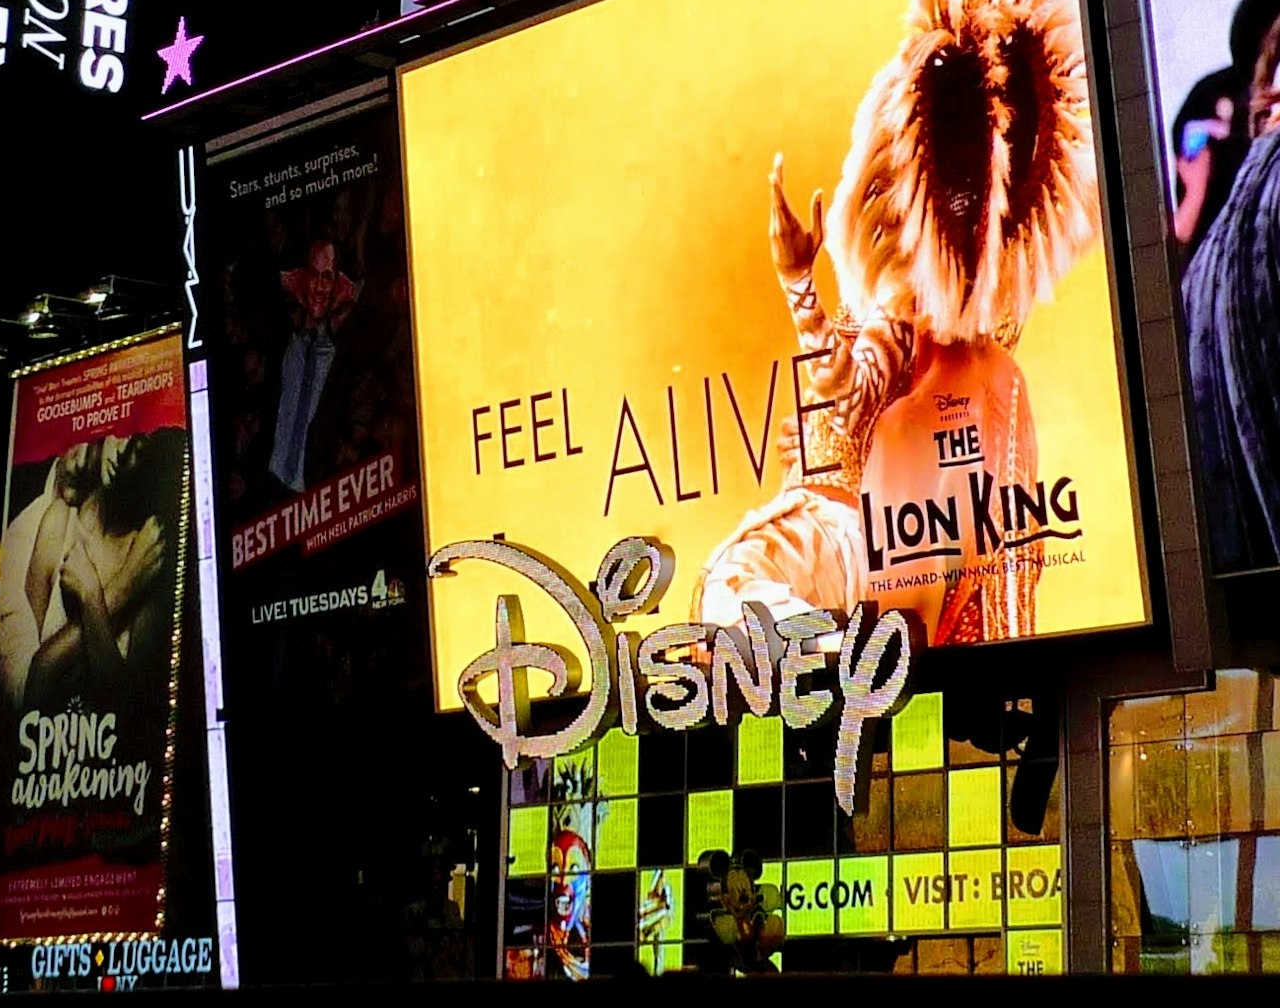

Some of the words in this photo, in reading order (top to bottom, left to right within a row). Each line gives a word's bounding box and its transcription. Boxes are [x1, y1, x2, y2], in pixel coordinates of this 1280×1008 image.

[229, 178, 262, 199] Stars,
[304, 143, 360, 174] surprises,
[265, 184, 287, 209] and
[289, 186, 303, 201] so
[305, 167, 340, 196] much
[342, 152, 379, 182] more!
[35, 391, 104, 424] GOOSEBUMPS
[116, 370, 175, 401] TEARDROPS
[71, 415, 85, 433] TO
[86, 404, 119, 429] PROVE
[120, 400, 135, 420] IT
[471, 387, 584, 476] FEEL
[603, 348, 844, 518] ALIVE
[933, 424, 981, 462] THE
[231, 511, 279, 573] BEST
[280, 484, 333, 543] TIME
[337, 453, 395, 515] EVER
[305, 529, 328, 552] WITH
[328, 518, 348, 540] NEIL
[348, 500, 384, 531] PATRICK
[384, 484, 418, 513] HARRIS
[860, 491, 961, 572] LION
[968, 469, 1080, 556] KING
[251, 600, 288, 625] LIVE!
[289, 583, 369, 619] TUESDAYS
[371, 568, 388, 601] 4
[870, 579, 893, 593] THE
[895, 564, 999, 591] AWARD-WINNING
[1001, 558, 1028, 574] BEST
[1030, 549, 1086, 573] MUSICAL
[17, 708, 118, 775] SPRING
[10, 748, 153, 817] awakening
[7, 877, 48, 893] EXTREMELY
[50, 874, 82, 890] LIMITED
[785, 879, 874, 911] G.COM
[903, 872, 980, 906] VISIT:
[30, 942, 93, 980] GIFTS
[106, 936, 213, 979] LUGGAGE
